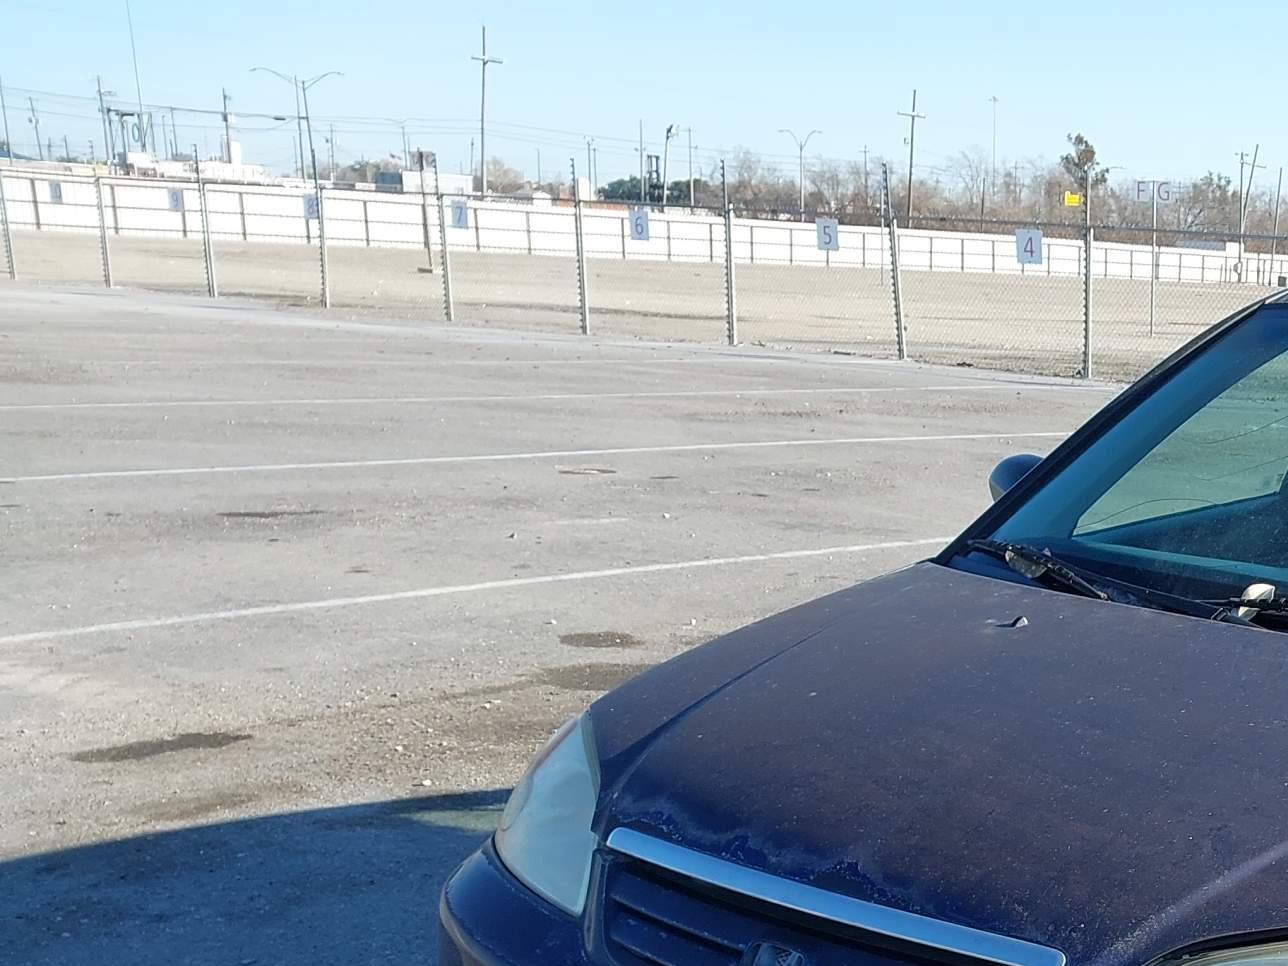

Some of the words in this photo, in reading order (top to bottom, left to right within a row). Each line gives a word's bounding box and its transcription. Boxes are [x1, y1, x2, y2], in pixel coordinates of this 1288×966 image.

[1137, 181, 1146, 200] F
[1157, 182, 1170, 201] G
[455, 206, 464, 224] 7
[634, 216, 644, 235] 6
[823, 225, 833, 245] 5
[1023, 236, 1035, 258] 4
